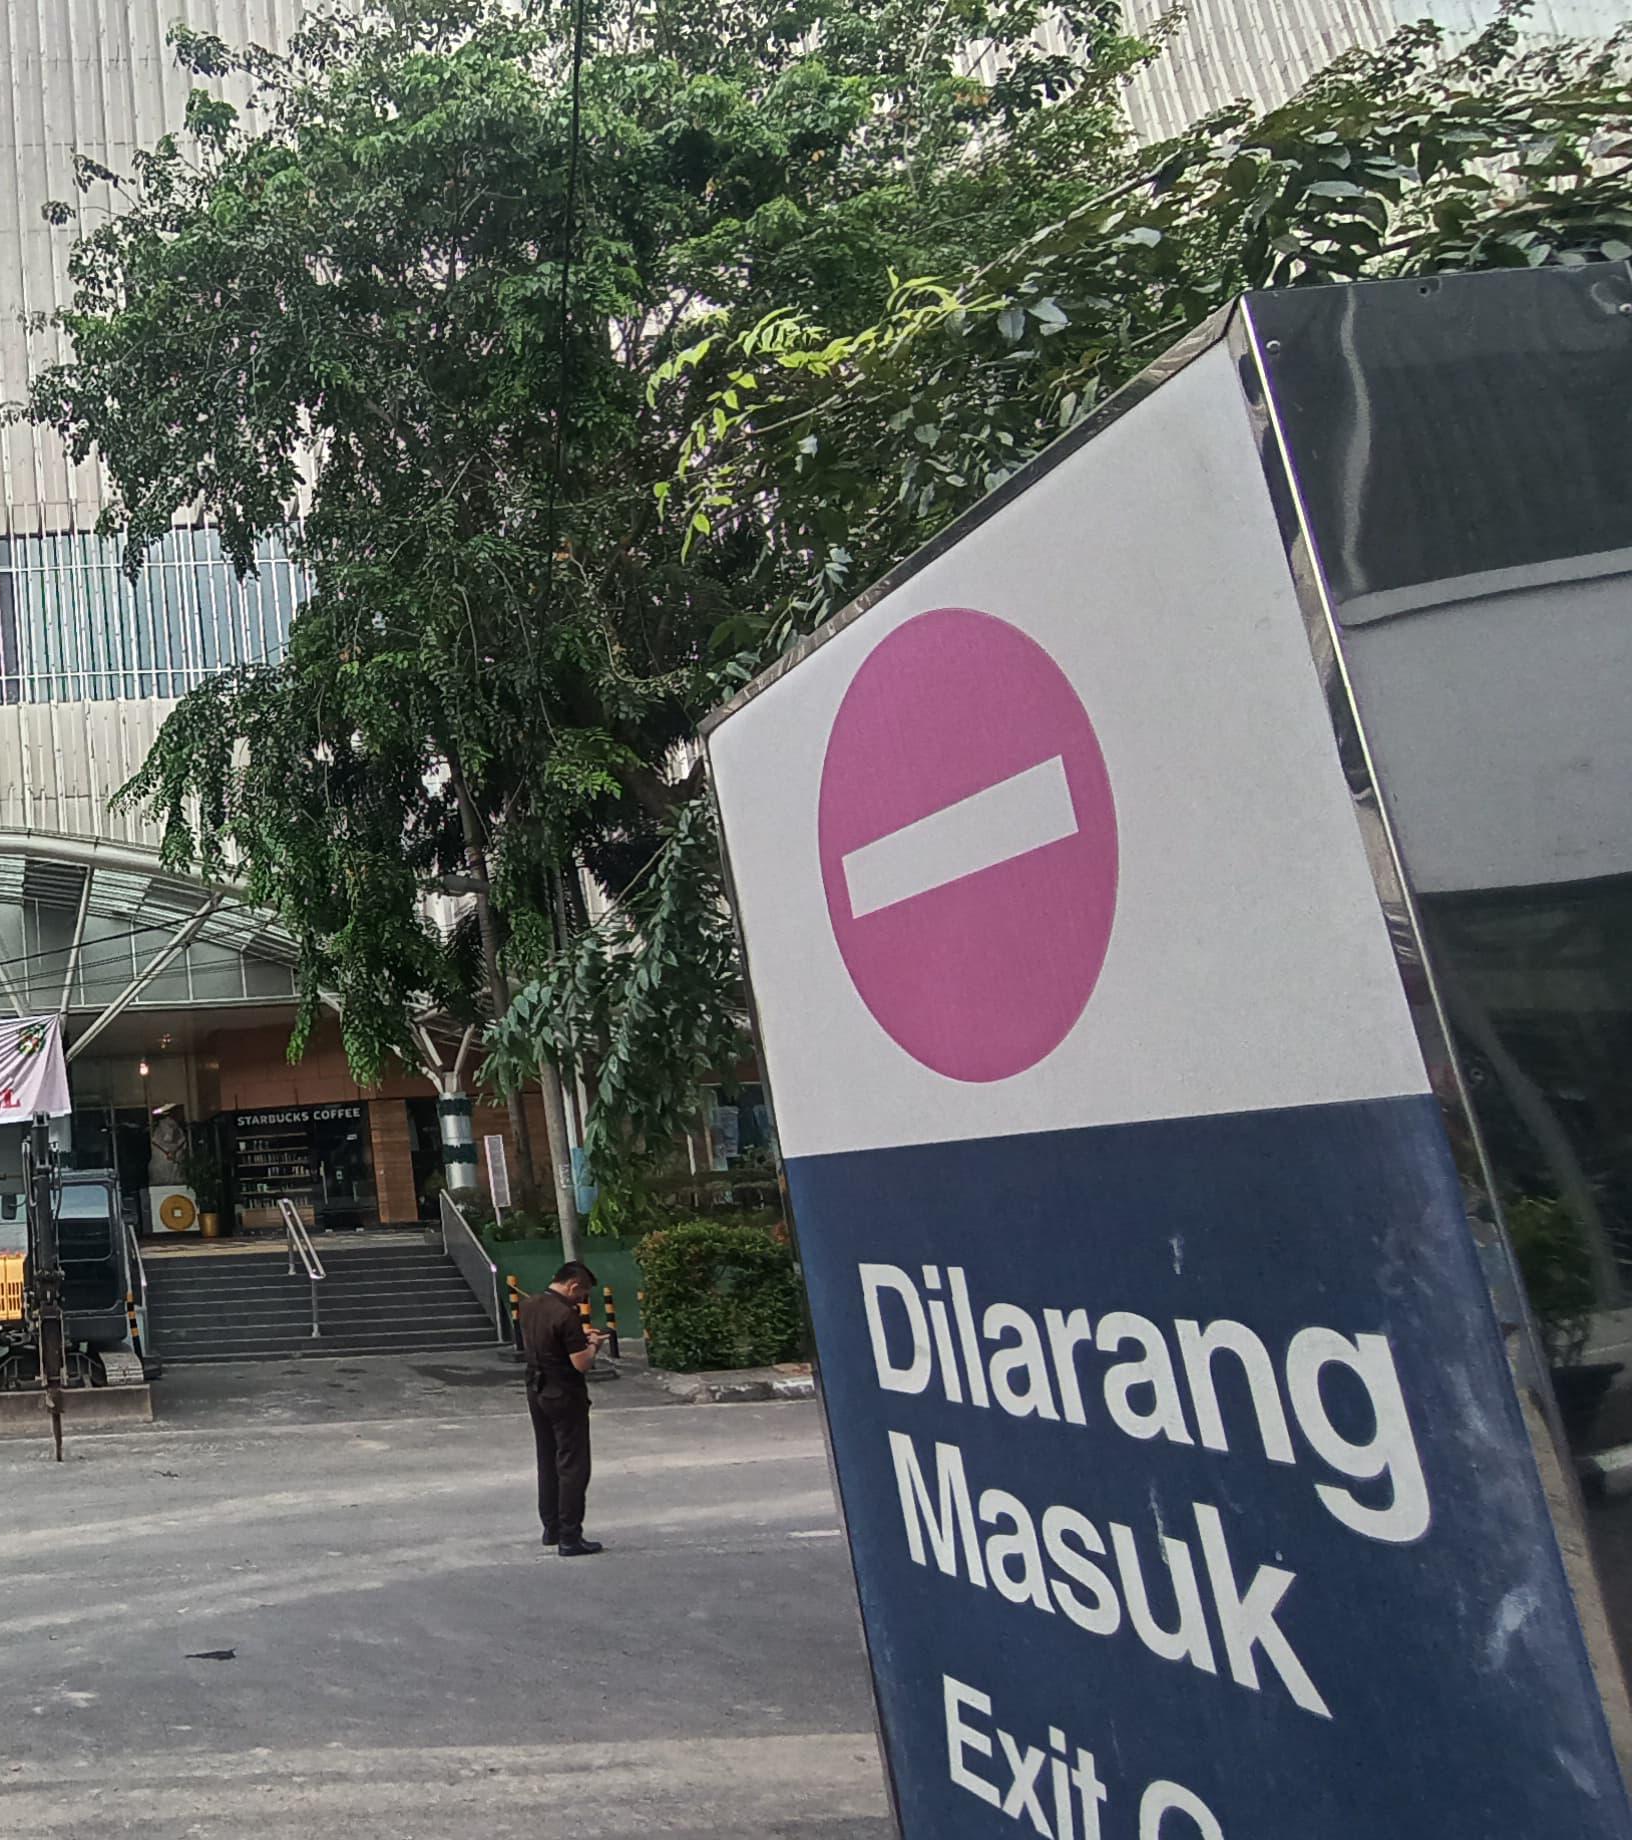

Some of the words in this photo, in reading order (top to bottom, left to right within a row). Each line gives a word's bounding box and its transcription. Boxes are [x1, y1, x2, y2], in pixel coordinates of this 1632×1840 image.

[237, 1111, 309, 1127] STARBUCKS
[313, 1107, 361, 1121] COFFEE
[858, 1262, 1431, 1543] Dilarang
[888, 1431, 1333, 1720] Masuk
[942, 1672, 1108, 1840] Exit
